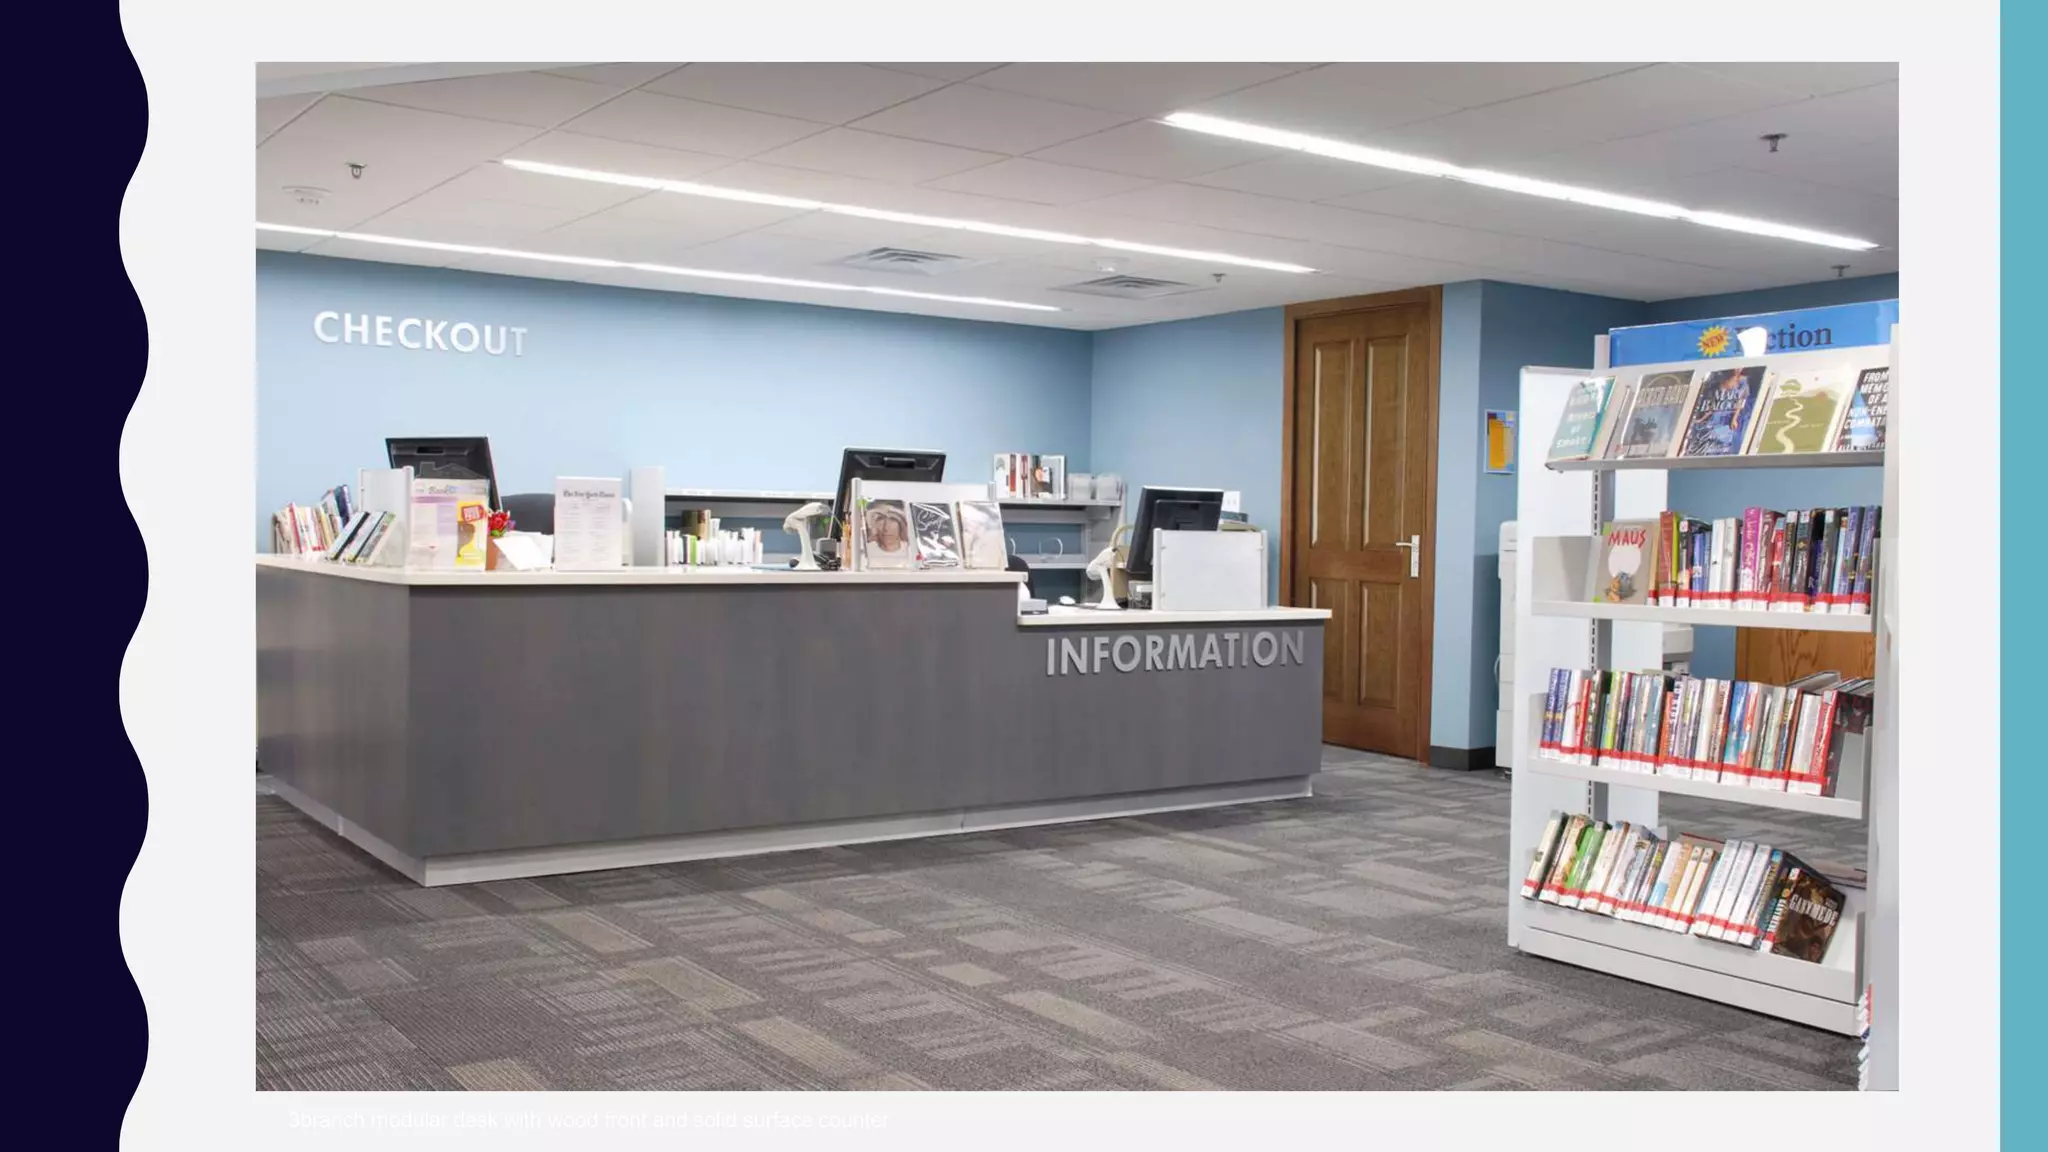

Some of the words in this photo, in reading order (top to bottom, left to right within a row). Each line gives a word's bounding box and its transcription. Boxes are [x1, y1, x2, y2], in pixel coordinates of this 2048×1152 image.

[313, 310, 528, 356] CHECKOUT
[1702, 334, 1725, 349] NEW
[1863, 371, 1889, 383] FROM
[1867, 394, 1879, 405] OF
[1608, 529, 1646, 548] MAUS
[1047, 631, 1304, 676] INFORMATION
[1789, 893, 1839, 927] GANYMEDE
